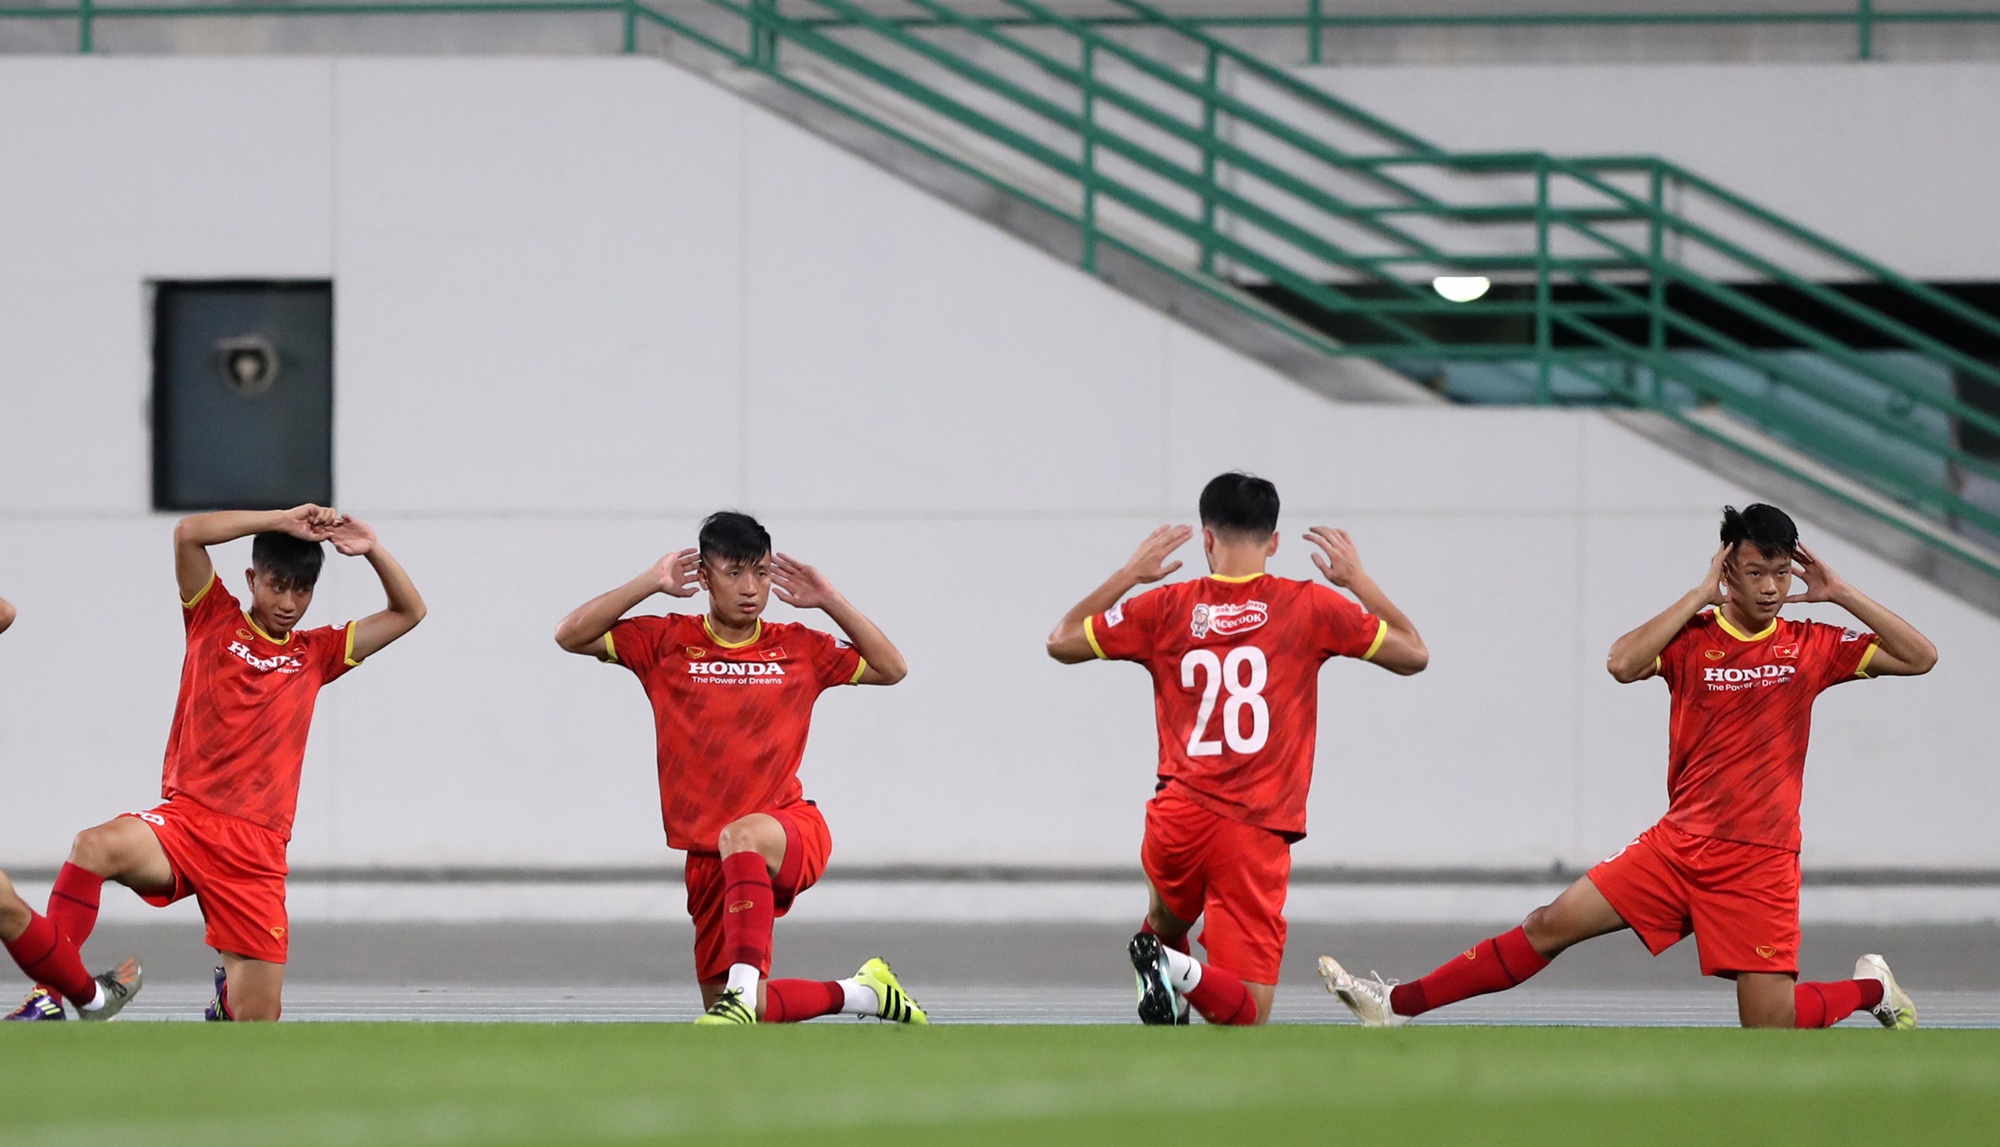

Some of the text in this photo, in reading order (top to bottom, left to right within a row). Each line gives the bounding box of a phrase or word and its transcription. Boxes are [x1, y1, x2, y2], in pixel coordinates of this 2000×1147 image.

[688, 661, 785, 676] HONDA
[1703, 664, 1796, 682] HONDA
[692, 676, 783, 685] The Power of Dreams
[1707, 683, 1725, 691] The
[1181, 646, 1270, 757] 28
